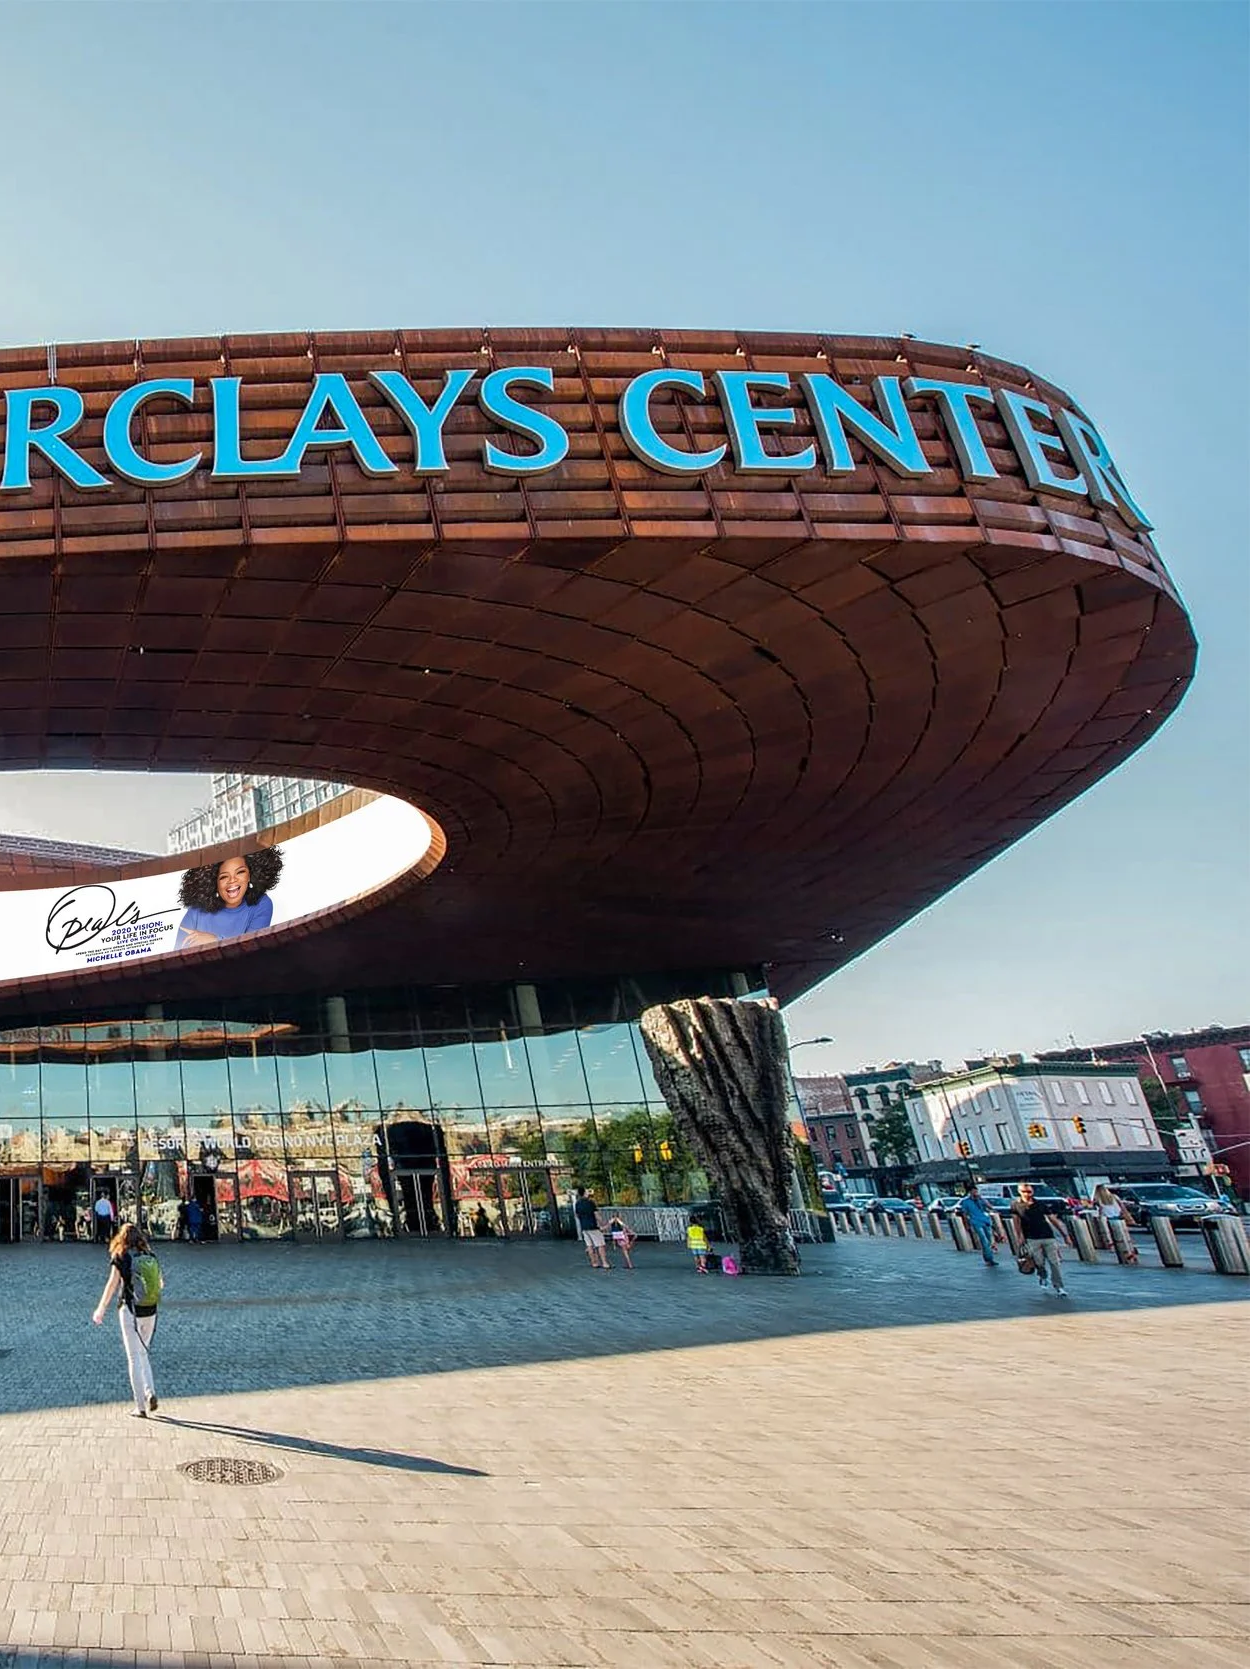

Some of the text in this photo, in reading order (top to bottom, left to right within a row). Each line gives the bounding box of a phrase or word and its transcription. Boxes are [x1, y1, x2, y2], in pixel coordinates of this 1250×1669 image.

[618, 368, 1155, 532] CENTER
[101, 933, 121, 943] YOUR
[123, 931, 137, 940] LIFE
[149, 923, 174, 935] FOCUS
[111, 920, 163, 936] 2020 VISION:
[86, 946, 152, 963] MICHELLE OBAMA
[143, 1133, 383, 1150] RESORS WORLD CASINO NYC PLAZA
